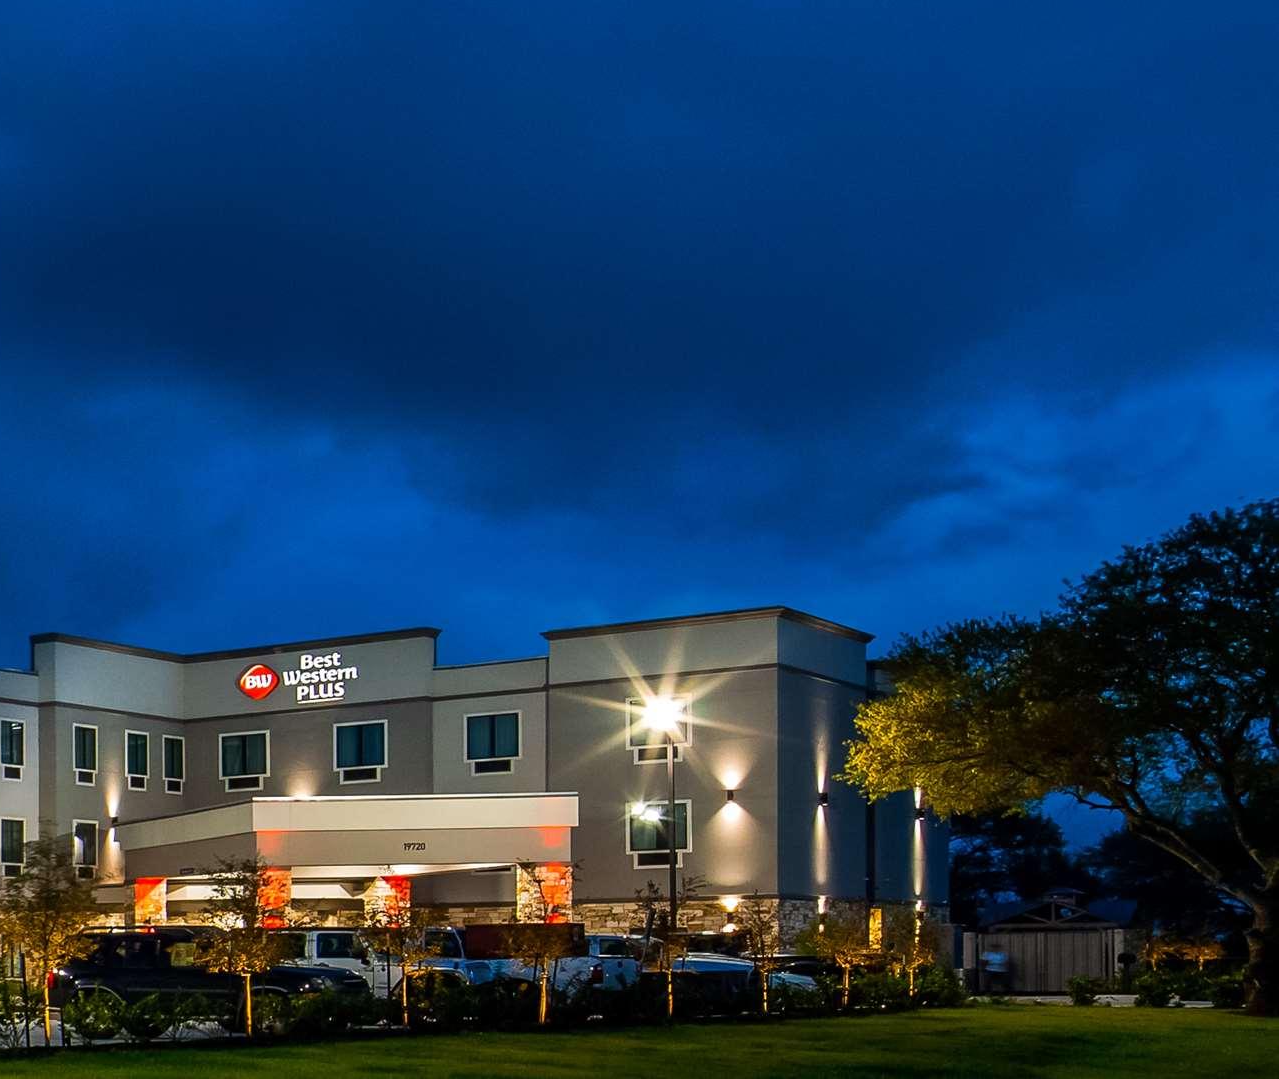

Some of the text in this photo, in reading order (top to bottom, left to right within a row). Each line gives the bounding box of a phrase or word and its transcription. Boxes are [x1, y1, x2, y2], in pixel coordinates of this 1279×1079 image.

[300, 652, 341, 670] Best
[245, 672, 273, 689] BW
[282, 666, 358, 686] Western
[296, 681, 345, 701] PLUS
[403, 842, 426, 851] 19720
